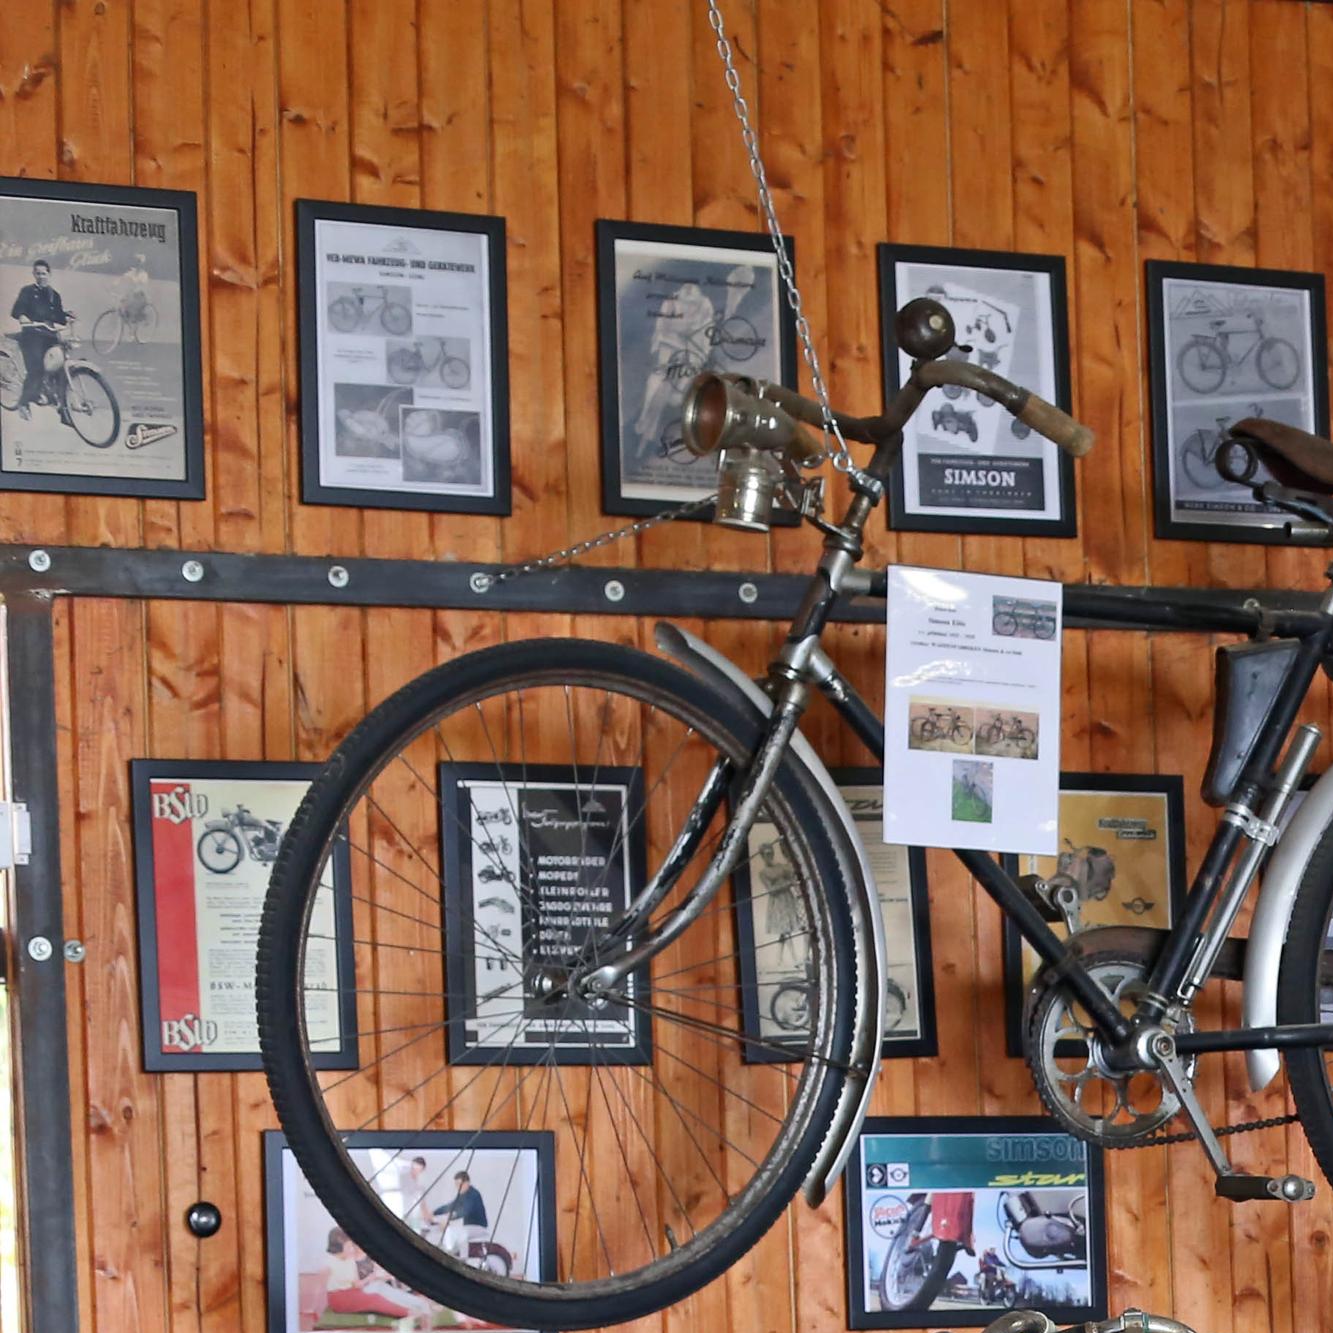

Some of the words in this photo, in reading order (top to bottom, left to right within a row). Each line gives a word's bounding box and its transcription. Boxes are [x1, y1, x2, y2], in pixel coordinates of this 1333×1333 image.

[71, 213, 166, 243] Kraftfahrzeug
[944, 468, 1016, 488] SIMSON
[988, 1171, 1086, 1187] star
